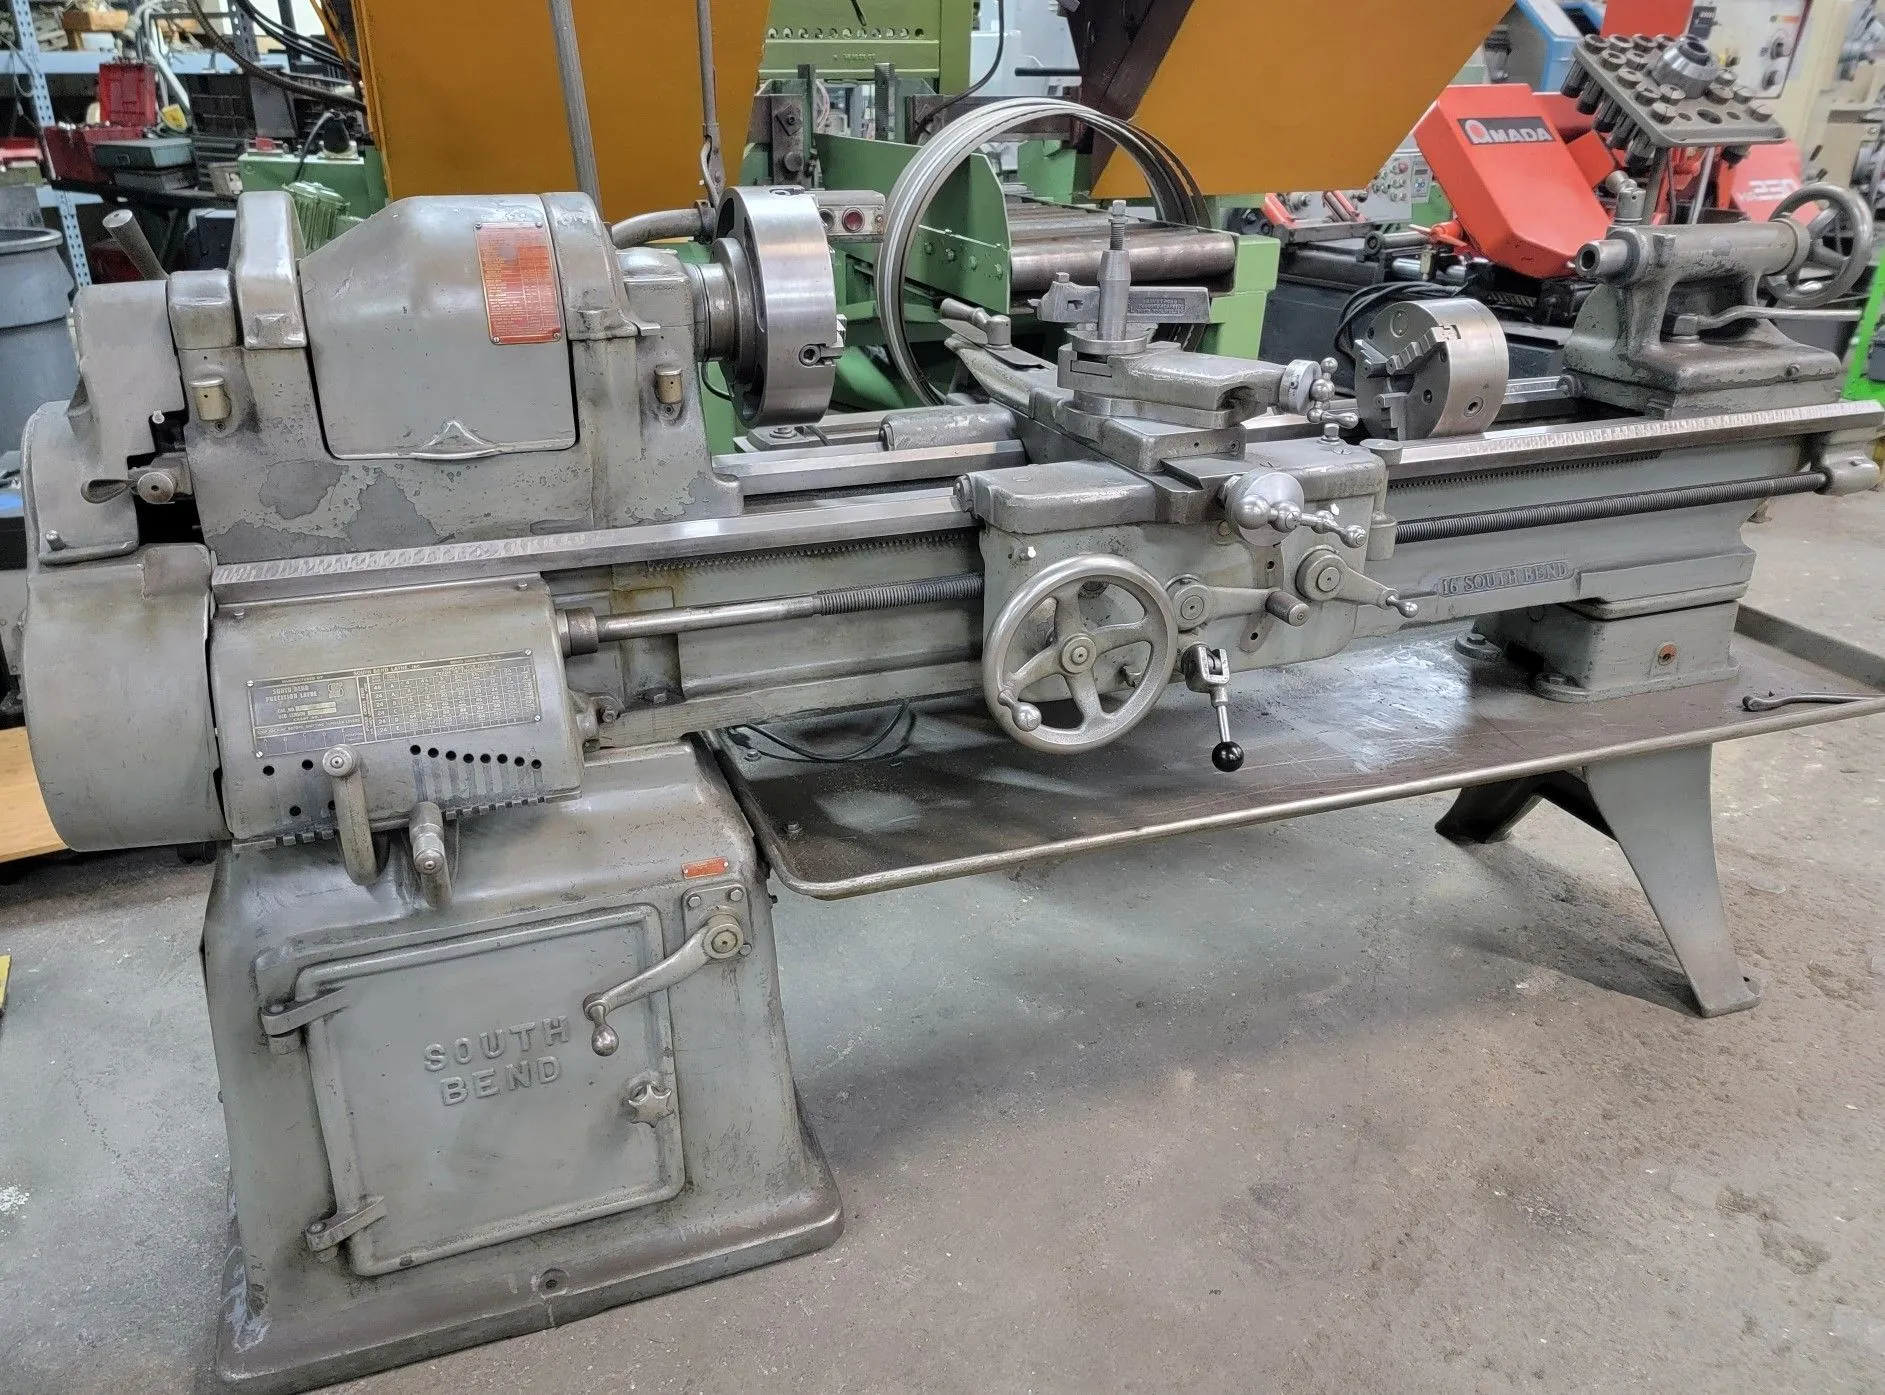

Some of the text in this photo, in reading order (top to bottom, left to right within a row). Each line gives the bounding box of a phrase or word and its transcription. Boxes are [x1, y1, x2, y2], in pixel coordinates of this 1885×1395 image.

[1465, 120, 1553, 144] AMADA
[1464, 570, 1517, 591] SOUTH
[1524, 562, 1567, 582] BEND
[424, 1016, 569, 1072] SOUTH
[440, 1056, 561, 1106] BEND
